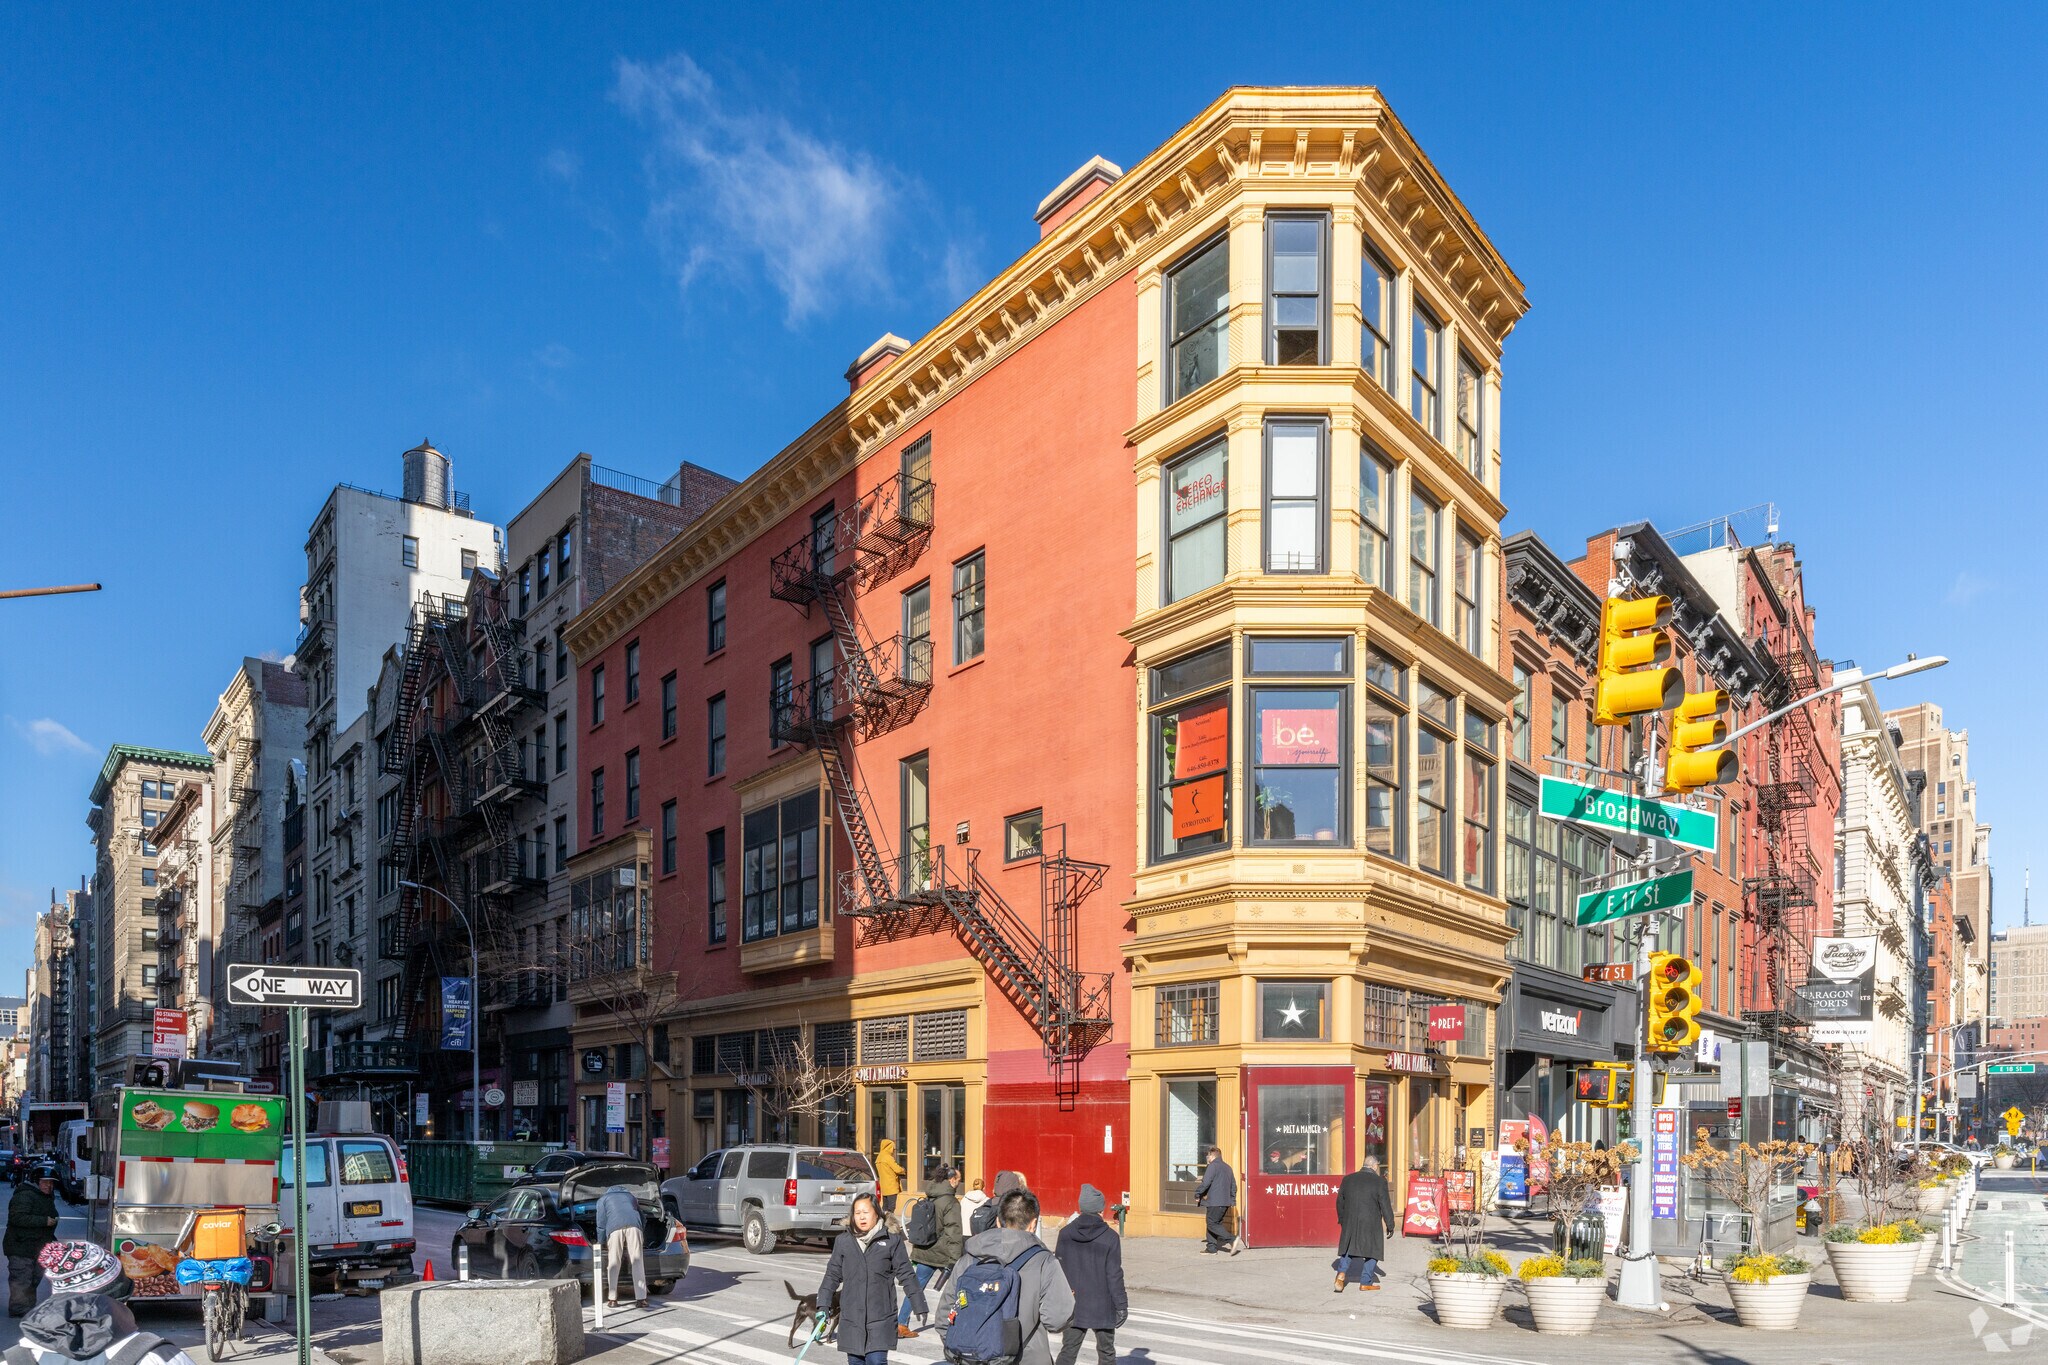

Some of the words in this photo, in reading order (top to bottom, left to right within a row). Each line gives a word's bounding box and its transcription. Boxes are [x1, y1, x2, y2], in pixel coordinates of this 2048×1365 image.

[1277, 718, 1320, 746] be.
[1585, 795, 1678, 837] Broadway
[1607, 895, 1614, 914] E
[1622, 890, 1637, 912] 17
[1644, 884, 1660, 907] St
[1824, 945, 1866, 960] Paragon
[1590, 968, 1595, 980] E
[1600, 968, 1609, 979] 17
[1614, 966, 1625, 979] St
[247, 978, 285, 993] ONE
[308, 980, 348, 994] WAY
[1802, 990, 1854, 1000] PARAGON
[1808, 1000, 1848, 1008] SPORTS
[1438, 1018, 1455, 1029] PRET
[1541, 1008, 1577, 1036] verizon
[157, 1033, 162, 1043] 3
[860, 1068, 872, 1080] PRET
[878, 1066, 900, 1080] MANGER
[1283, 1125, 1295, 1133] PRET
[1296, 1125, 1300, 1133] A
[1301, 1125, 1321, 1133] MANGER
[1658, 1153, 1672, 1161] LOTTO
[1276, 1183, 1293, 1195] PRET
[1294, 1183, 1299, 1195] A
[1300, 1183, 1329, 1195] MANGER
